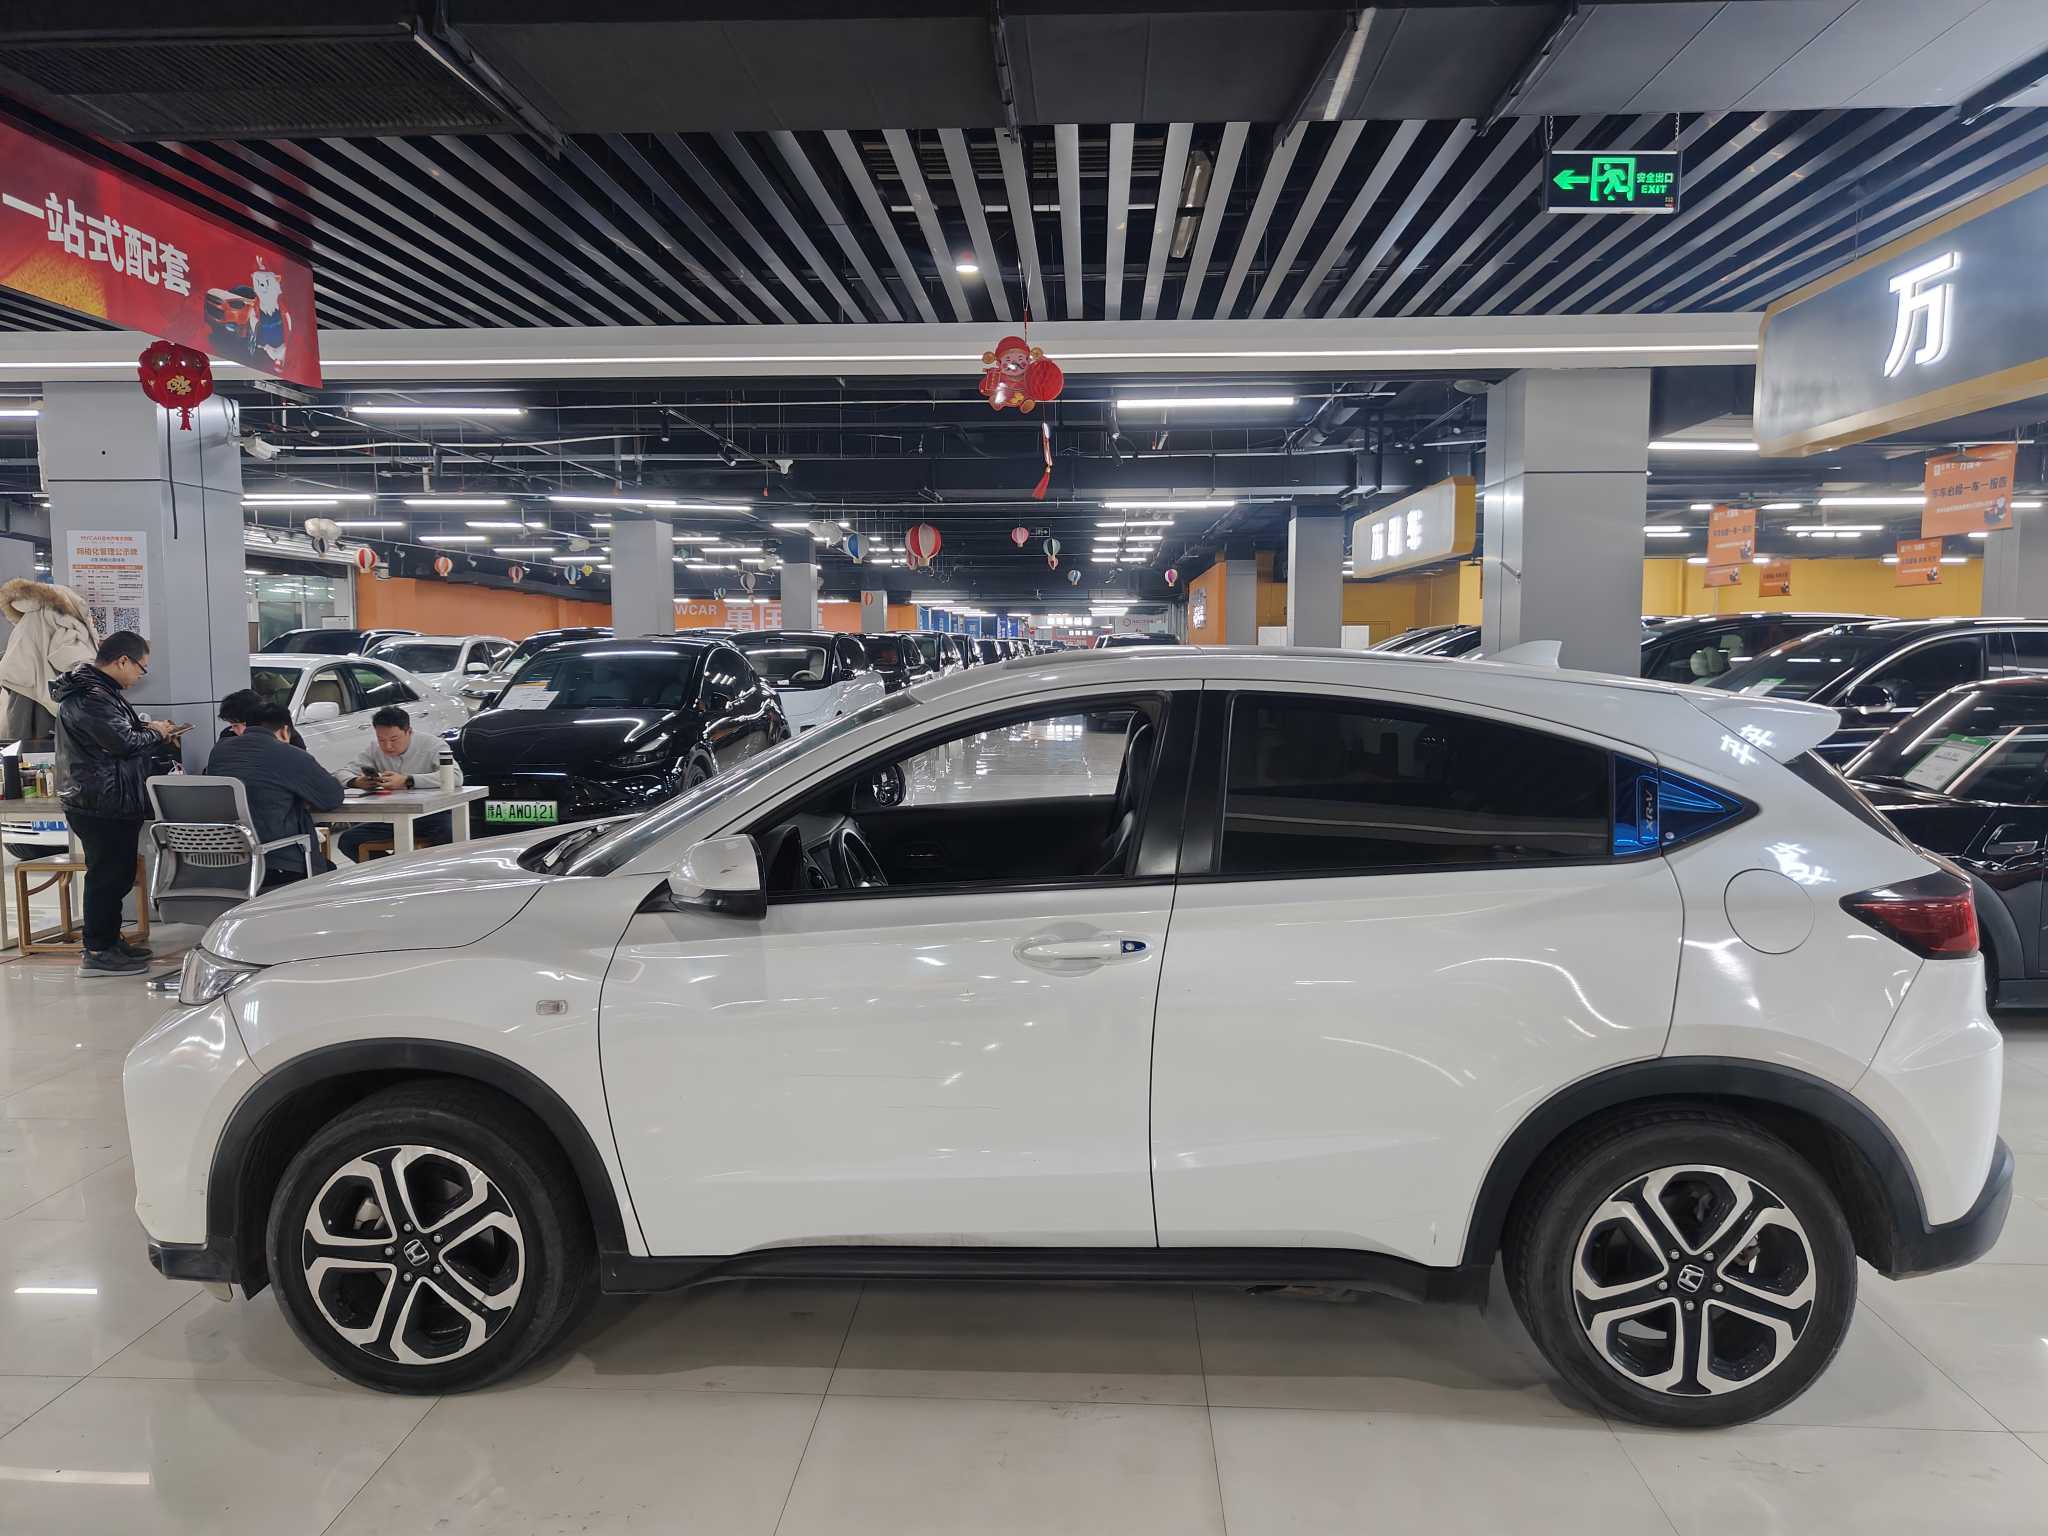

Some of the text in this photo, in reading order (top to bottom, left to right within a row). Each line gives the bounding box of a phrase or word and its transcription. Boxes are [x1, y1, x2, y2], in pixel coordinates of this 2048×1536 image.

[1636, 172, 1674, 184] 安全出口
[1640, 185, 1668, 194] EXIT
[2, 192, 191, 297] 一站式配套
[1884, 250, 1961, 378] 万
[674, 604, 717, 616] WCAR
